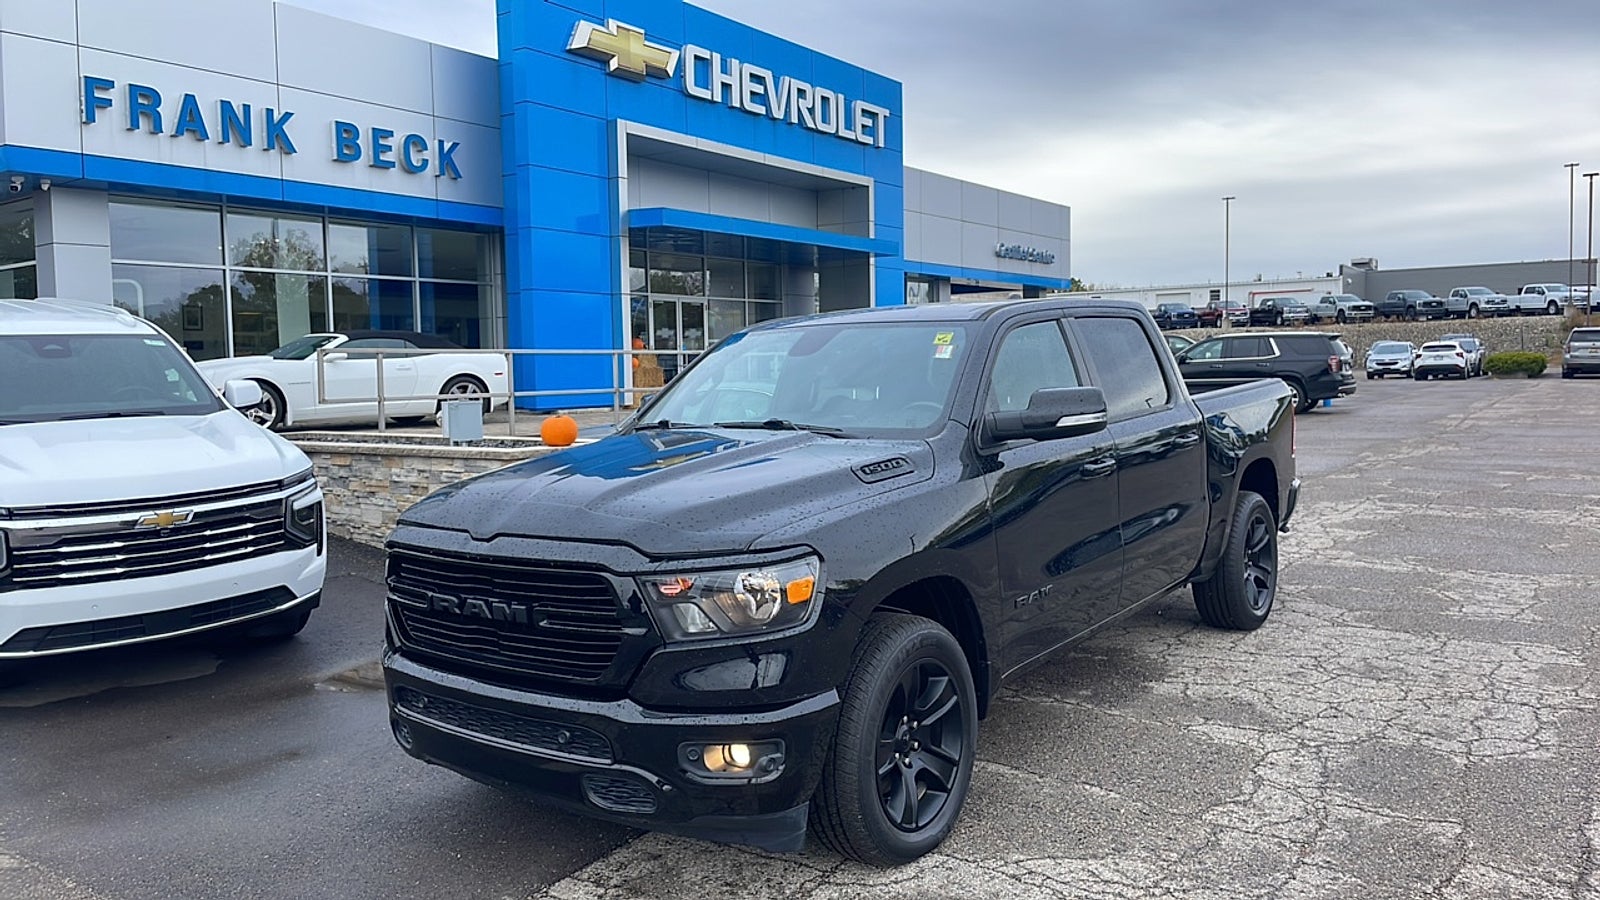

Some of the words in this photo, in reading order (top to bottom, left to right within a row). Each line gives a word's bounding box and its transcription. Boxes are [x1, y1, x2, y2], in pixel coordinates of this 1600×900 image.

[682, 44, 890, 148] CHEVROLET
[82, 75, 298, 155] FRANK
[332, 120, 462, 179] BECK
[860, 458, 905, 475] 1500
[432, 592, 528, 624] RAM
[1014, 584, 1053, 609] RAM
